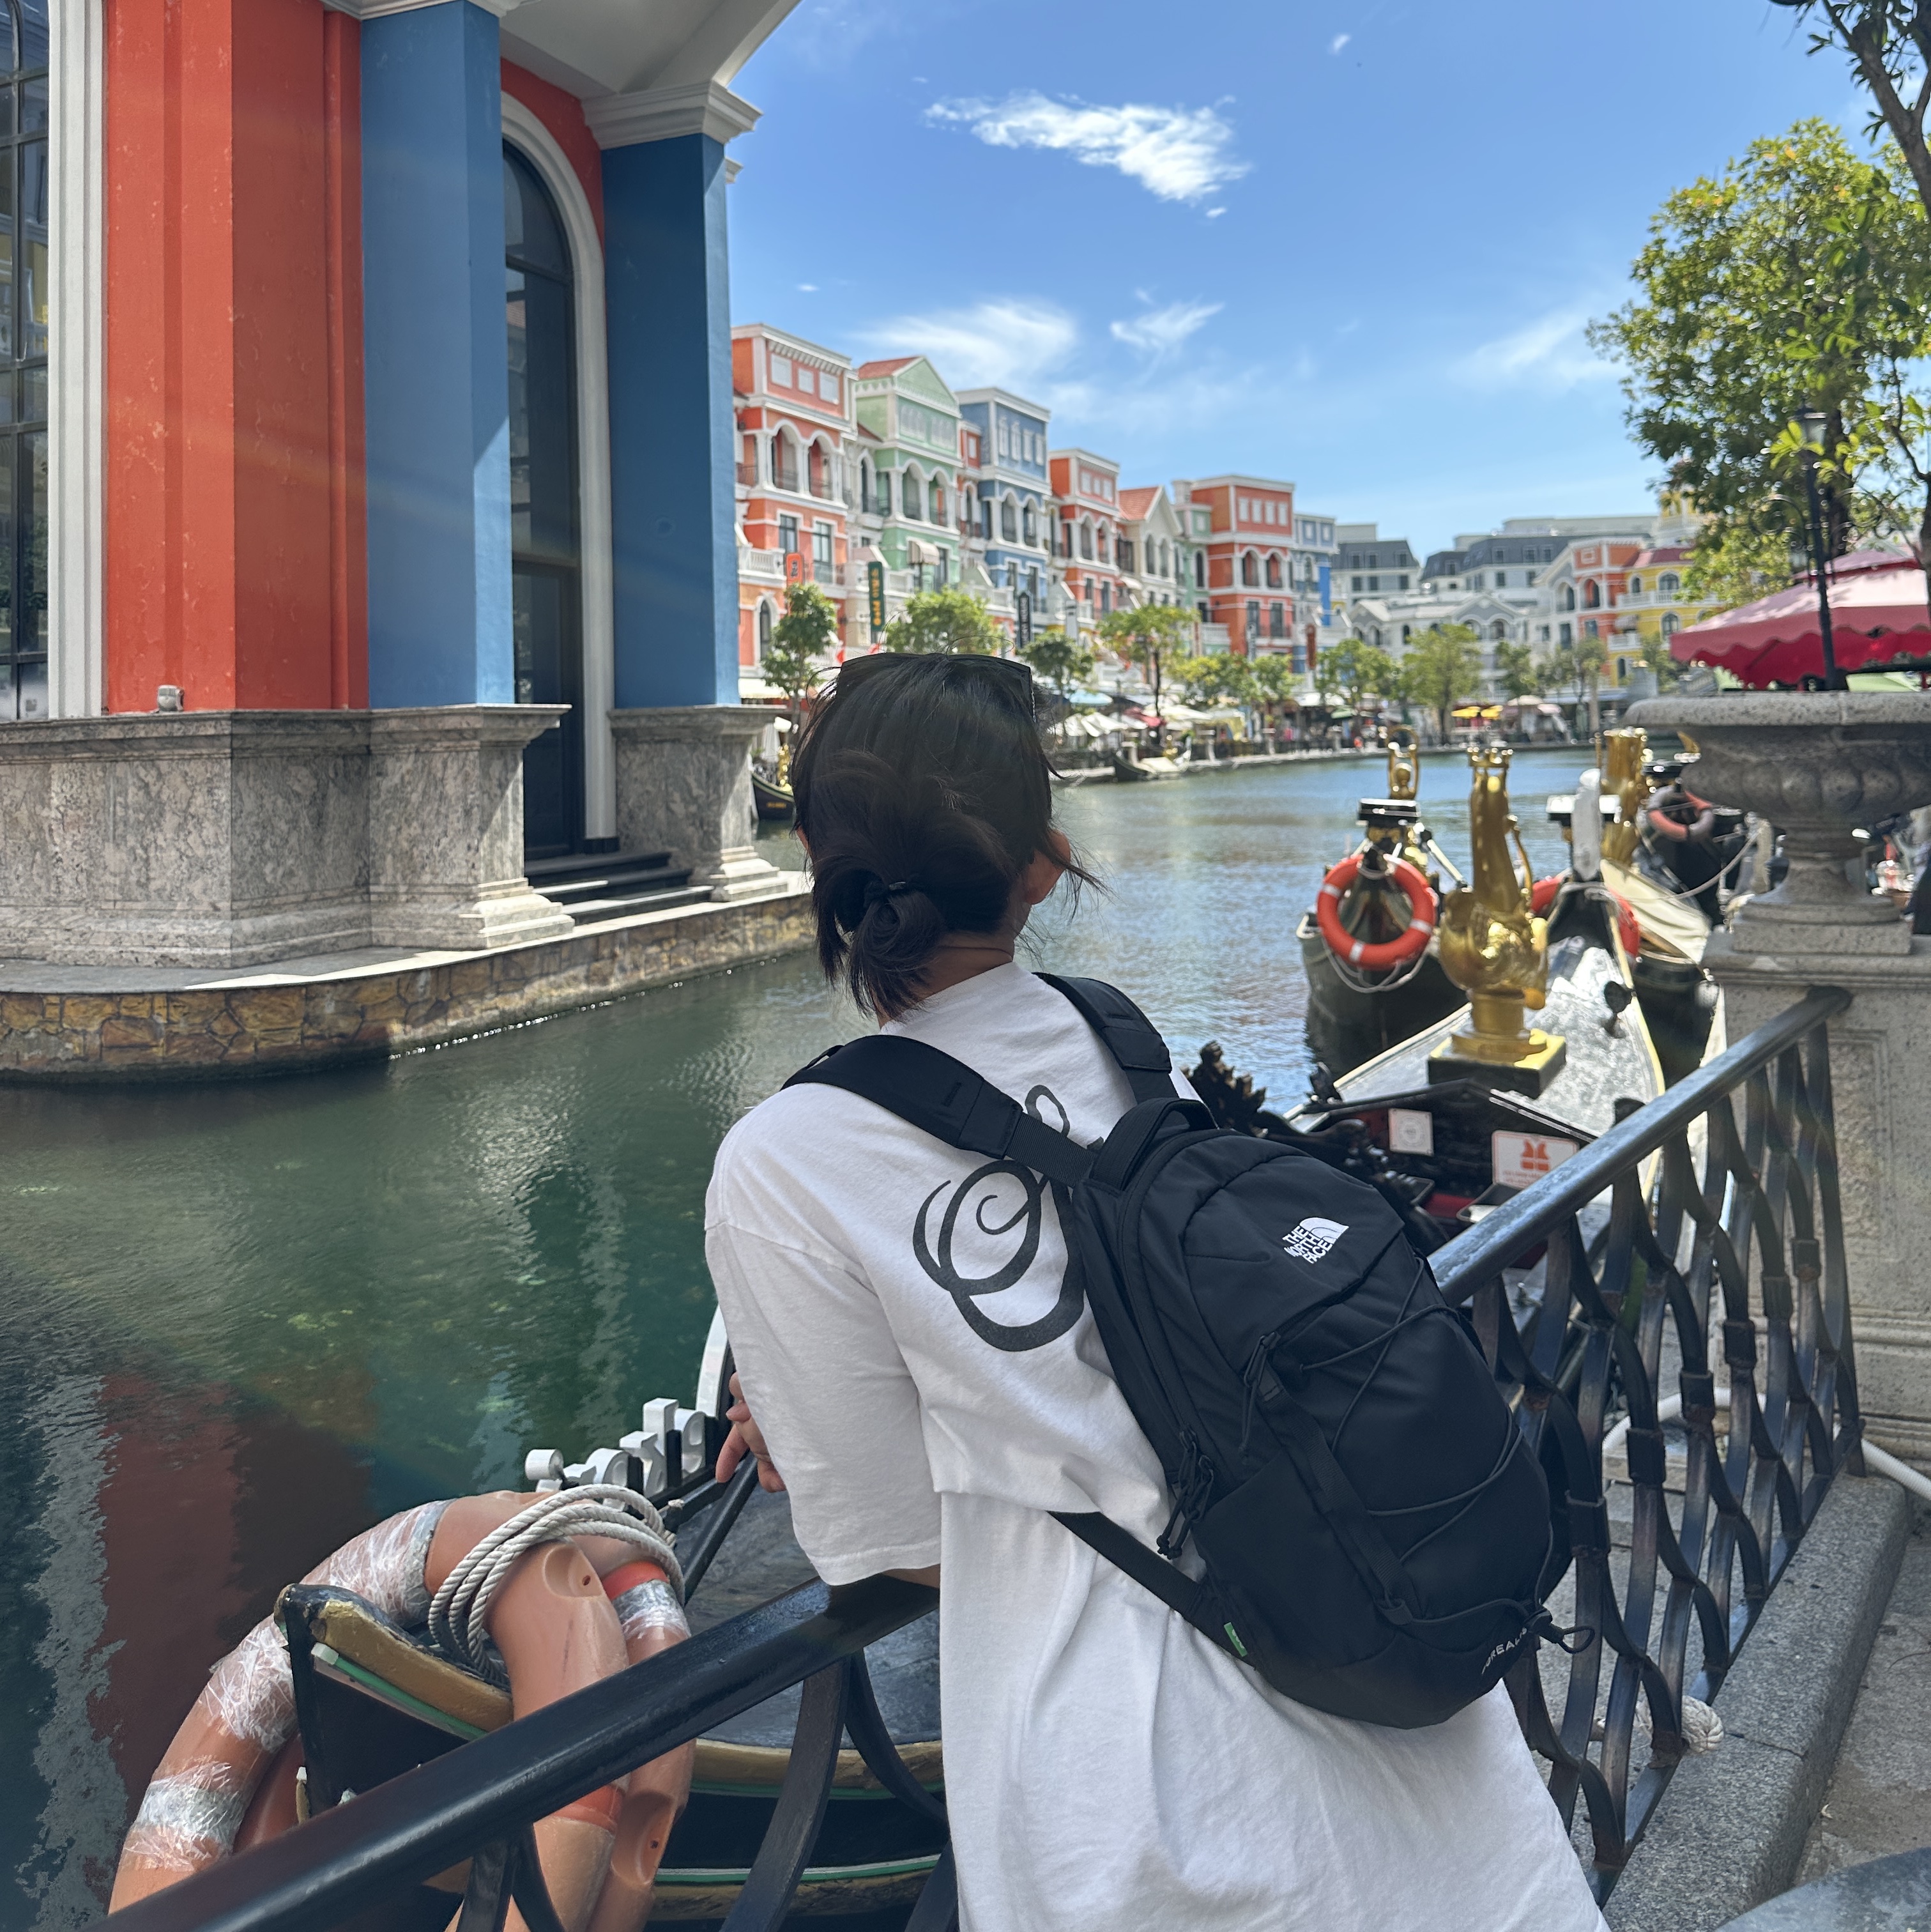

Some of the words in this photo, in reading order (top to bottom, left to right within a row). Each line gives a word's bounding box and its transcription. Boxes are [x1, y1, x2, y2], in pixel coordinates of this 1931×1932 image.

[1282, 1225, 1309, 1245] THE
[1283, 1232, 1322, 1257] NORTH
[1302, 1239, 1333, 1264] FACE
[1481, 1627, 1528, 1675] OREALI
